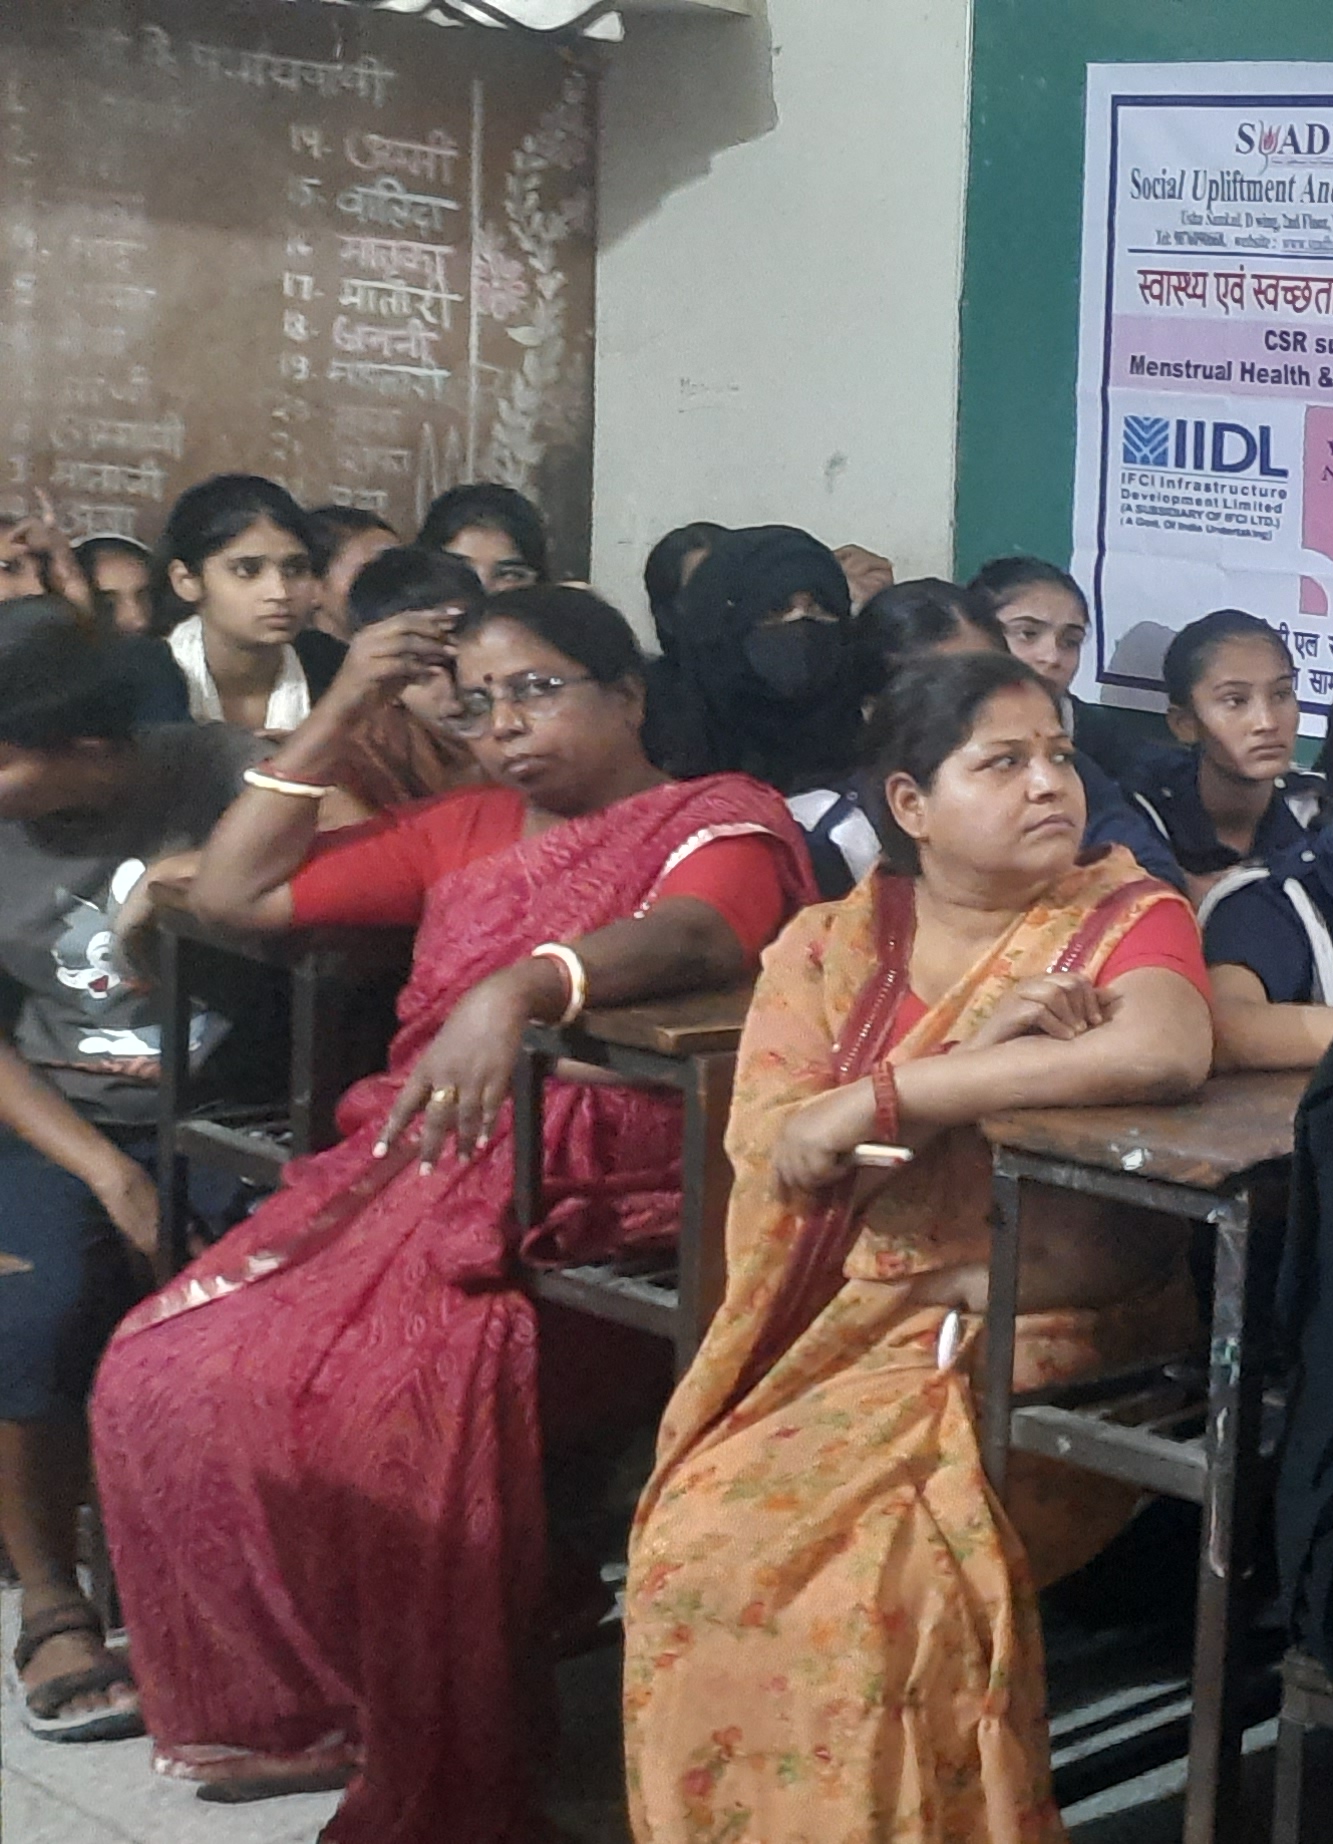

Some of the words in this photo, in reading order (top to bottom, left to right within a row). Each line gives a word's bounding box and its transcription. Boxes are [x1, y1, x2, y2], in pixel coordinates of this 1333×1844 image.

[1130, 168, 1186, 200] Social
[1191, 169, 1296, 211] Upliftment
[1137, 269, 1208, 308] स्वास्थ्य
[1214, 264, 1246, 315] एवं
[1264, 330, 1307, 352] CSR
[1129, 355, 1232, 381] Menstrual
[1240, 361, 1310, 387] Health
[1317, 366, 1333, 388] &
[1175, 418, 1289, 479] IIDL
[1120, 472, 1155, 488] IFCI
[1160, 476, 1287, 500] Infrastructure
[1120, 488, 1219, 508] Development
[1223, 498, 1283, 514] Limited
